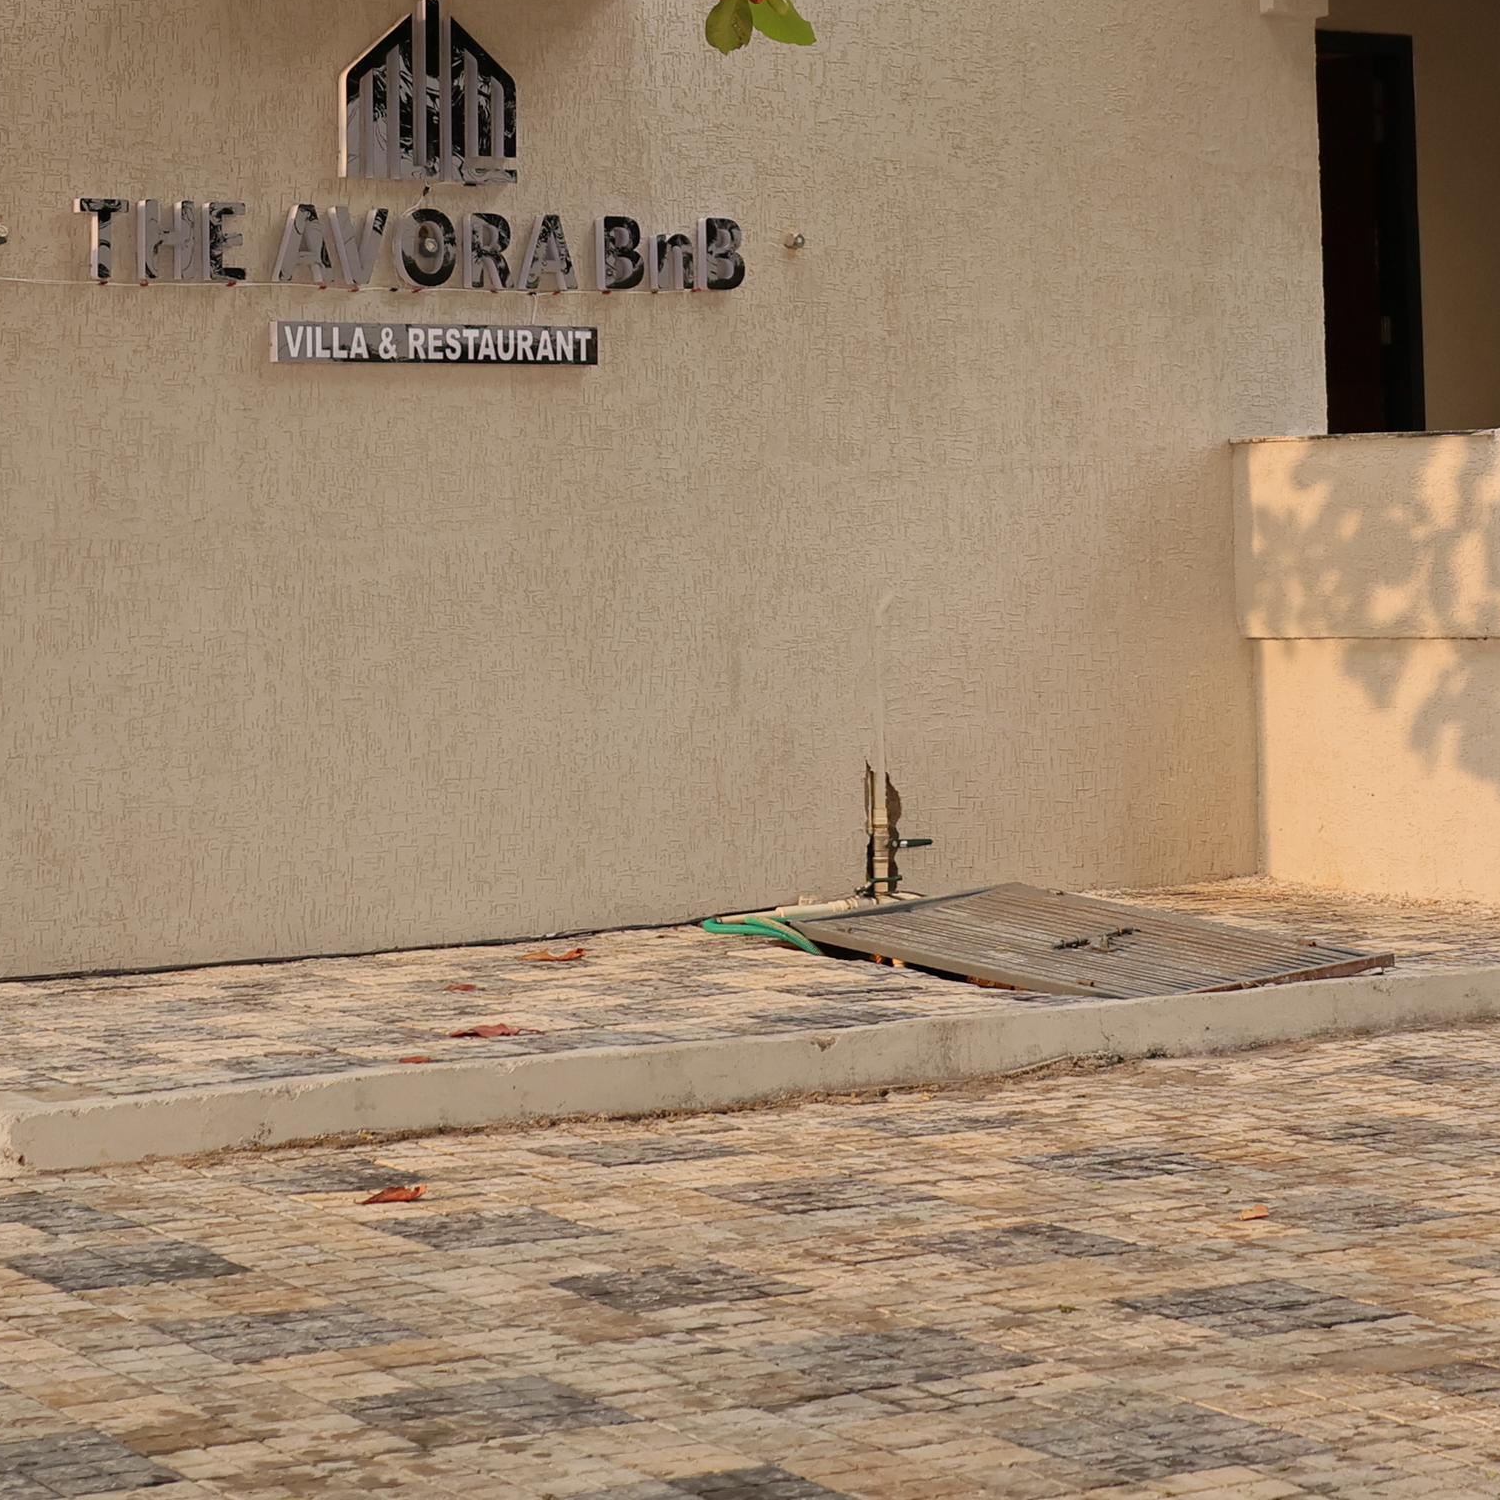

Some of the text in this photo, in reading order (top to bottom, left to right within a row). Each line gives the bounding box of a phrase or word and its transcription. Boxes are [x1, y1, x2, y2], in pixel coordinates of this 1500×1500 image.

[74, 198, 746, 290] THE AVORA BnB
[284, 325, 592, 362] VILLA & RESTAURANT
